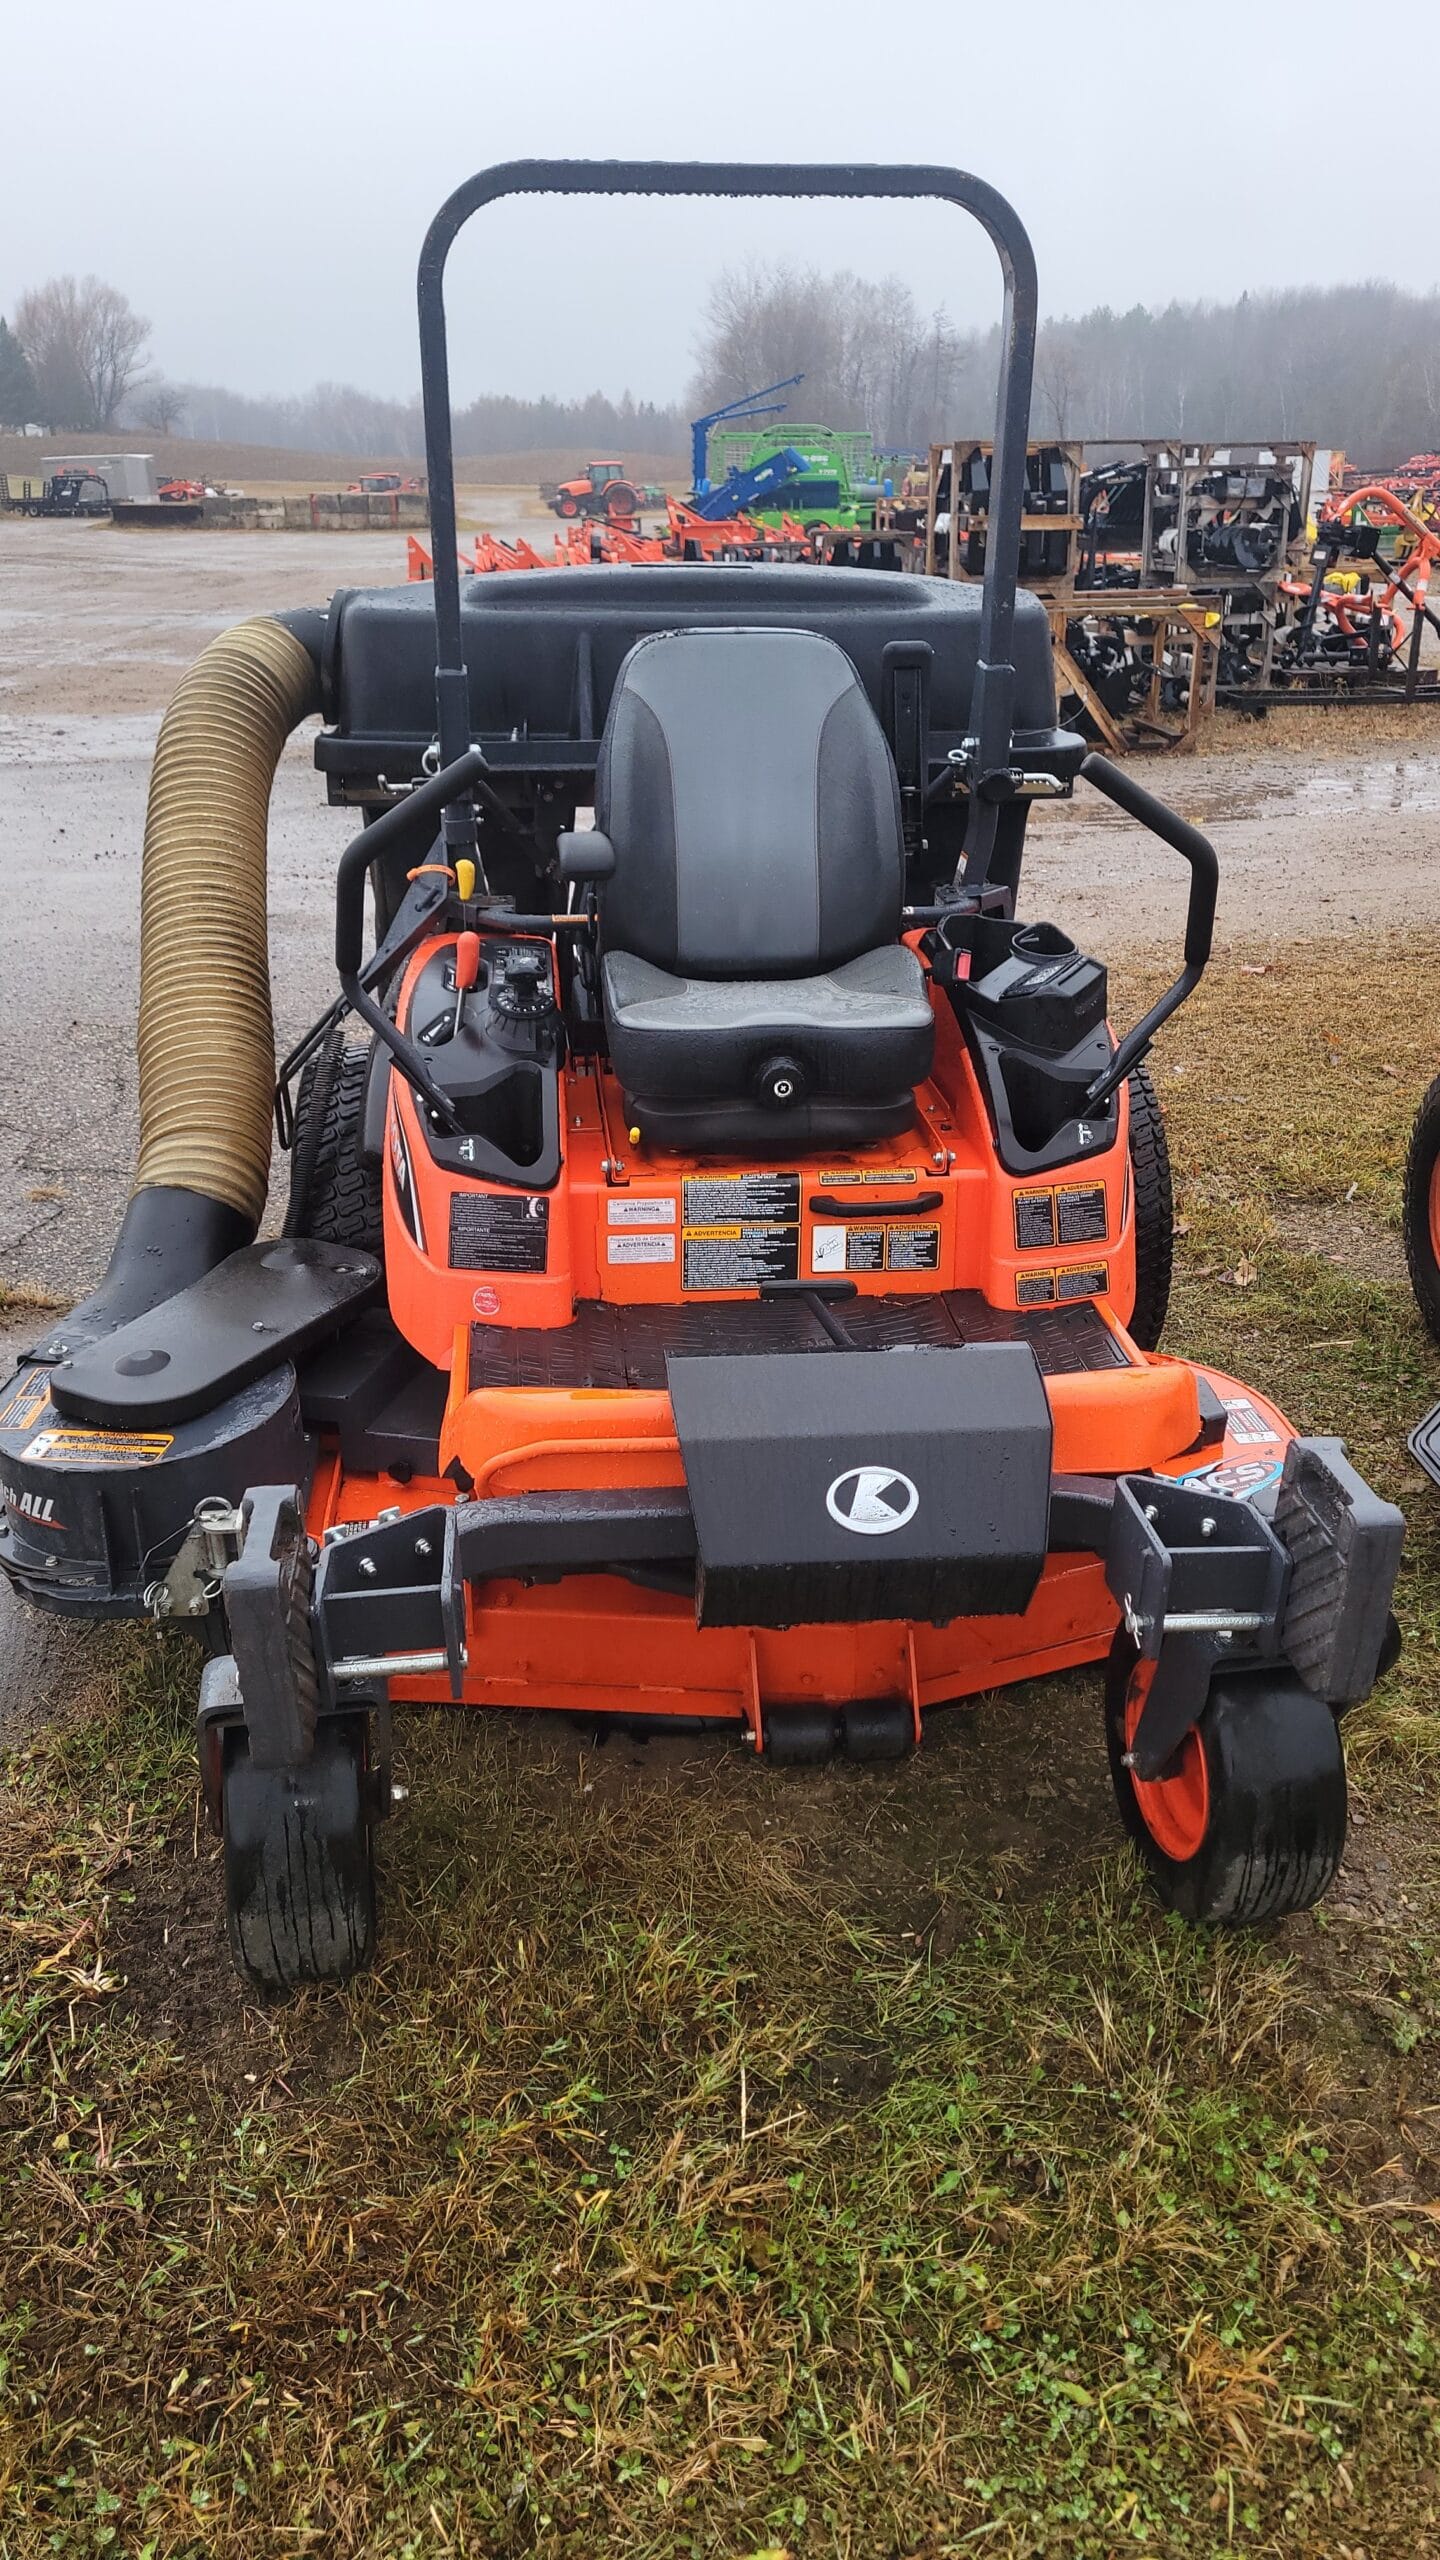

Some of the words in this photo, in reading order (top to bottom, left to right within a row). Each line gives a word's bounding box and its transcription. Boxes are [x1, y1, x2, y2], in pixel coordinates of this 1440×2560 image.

[1066, 1263, 1103, 1272] ADVERTENCIA
[80, 1443, 143, 1452] ADVERTENCIA
[20, 1492, 54, 1522] ALL
